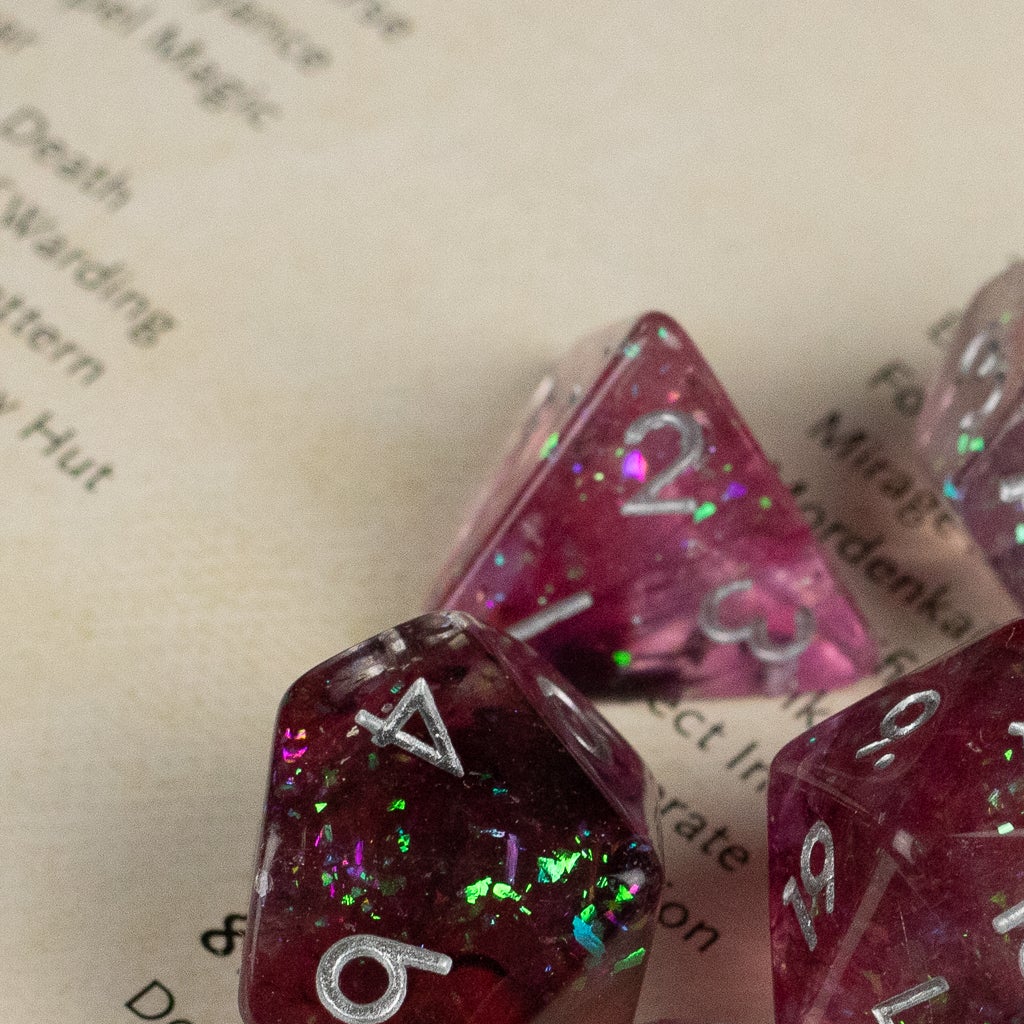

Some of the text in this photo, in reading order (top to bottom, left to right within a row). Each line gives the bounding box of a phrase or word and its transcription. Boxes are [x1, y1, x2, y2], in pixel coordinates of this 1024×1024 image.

[144, 22, 283, 133] Magic
[1, 104, 133, 213] Death
[0, 200, 178, 350] Warding
[18, 410, 115, 493] Hut
[622, 411, 706, 516] 2
[700, 578, 818, 664] 3
[354, 677, 466, 778] 4
[782, 820, 836, 952] 19
